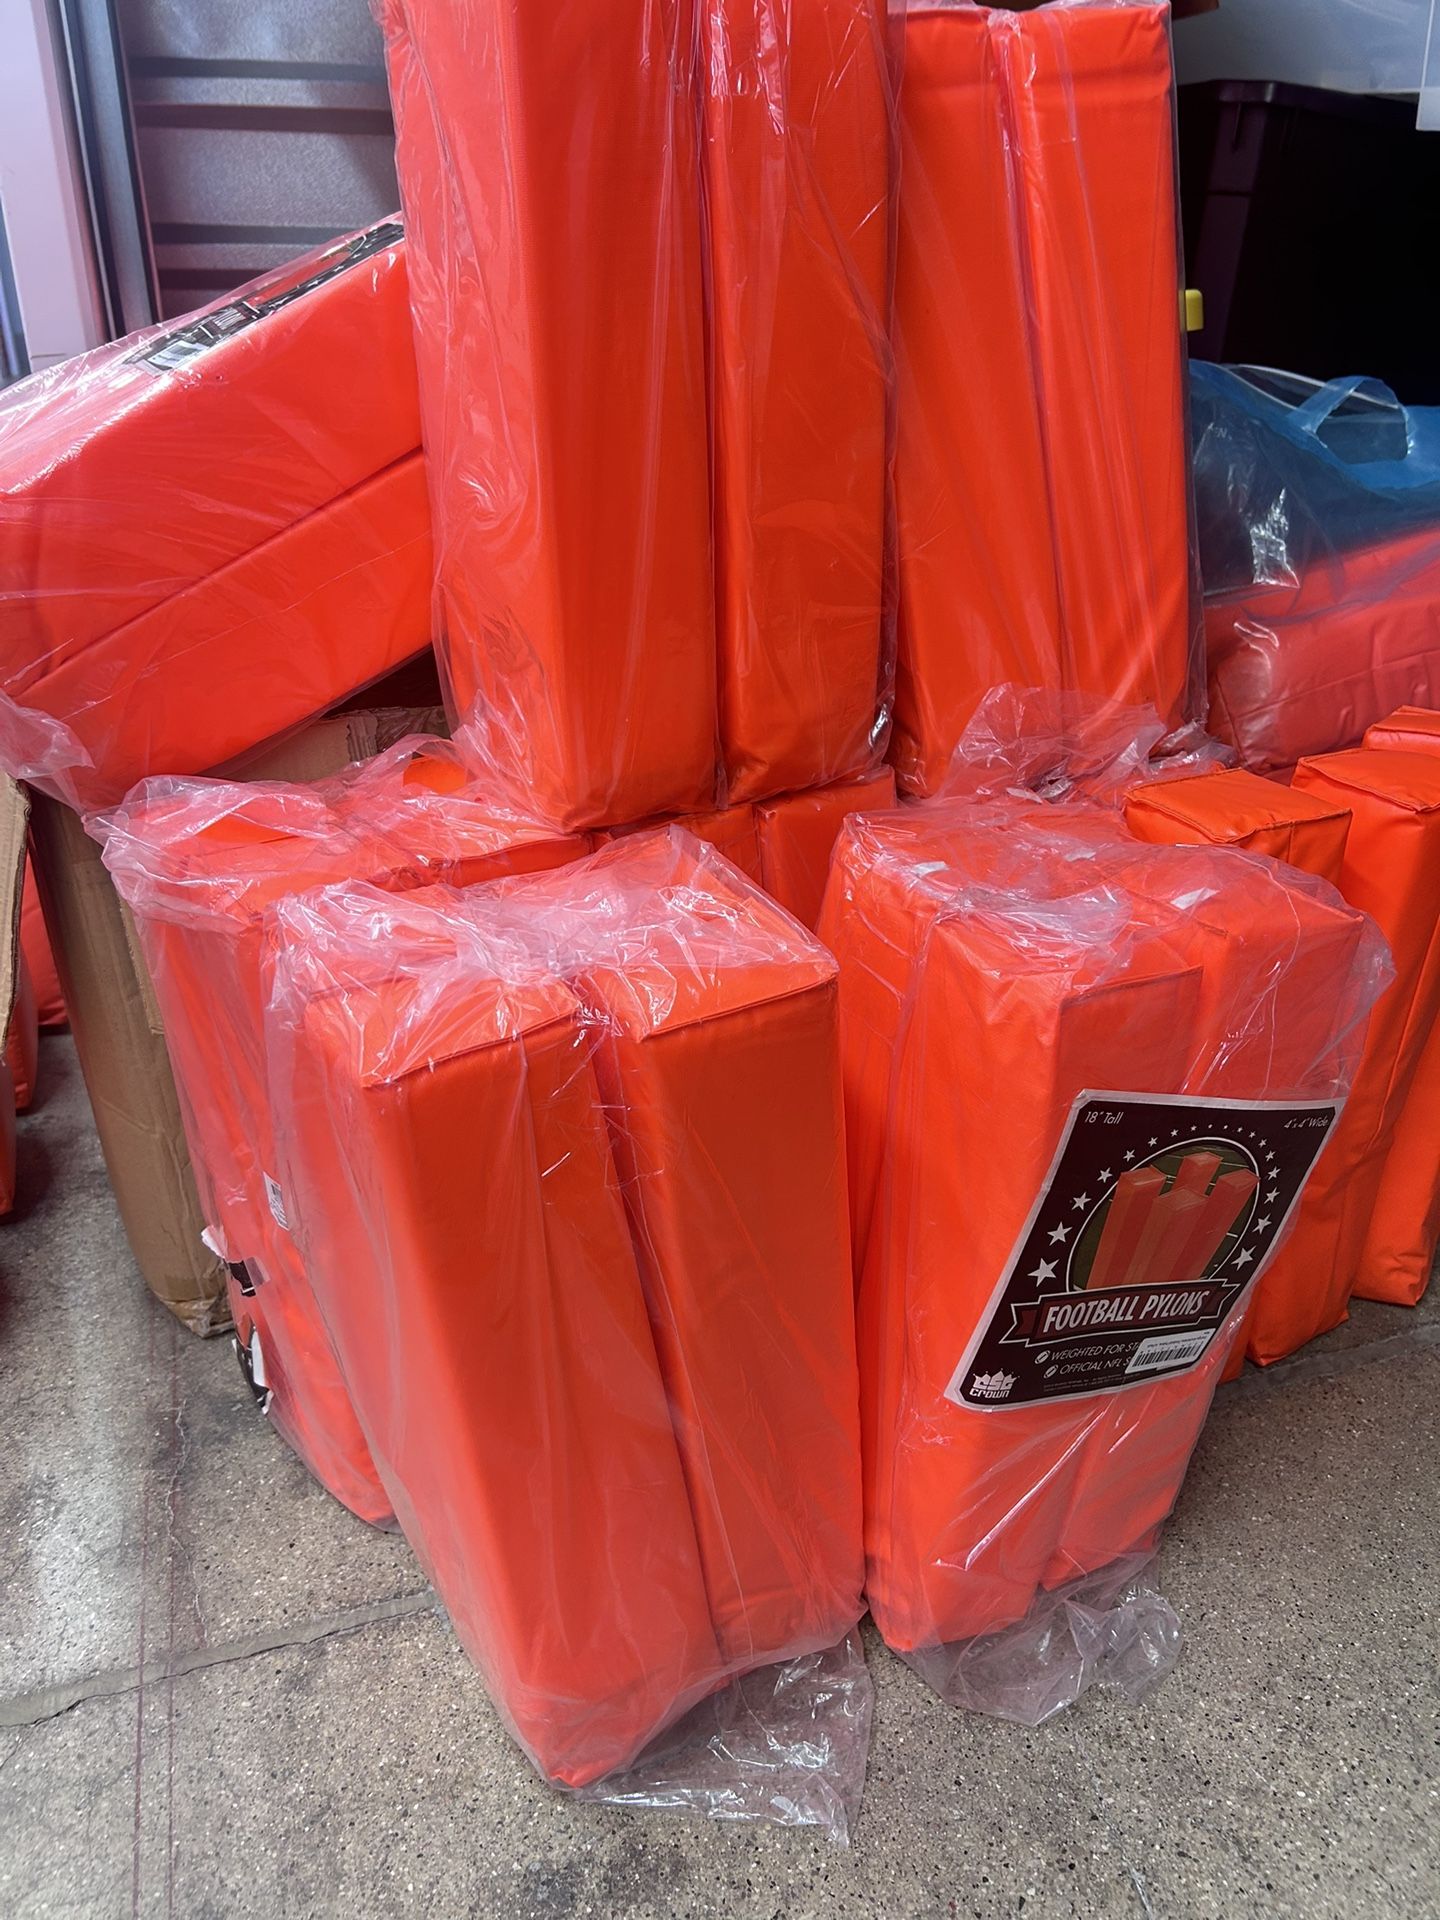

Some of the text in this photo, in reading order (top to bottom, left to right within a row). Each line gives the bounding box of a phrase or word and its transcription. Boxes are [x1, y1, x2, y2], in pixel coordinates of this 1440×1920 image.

[1104, 1111, 1124, 1125] Tall
[1043, 1290, 1210, 1333] FOOTBALL PYLONS
[1051, 1344, 1103, 1362] WEIGHTED
[1102, 1343, 1126, 1355] FOR
[1059, 1359, 1103, 1376] OFFICIAL
[1103, 1357, 1123, 1369] NFL
